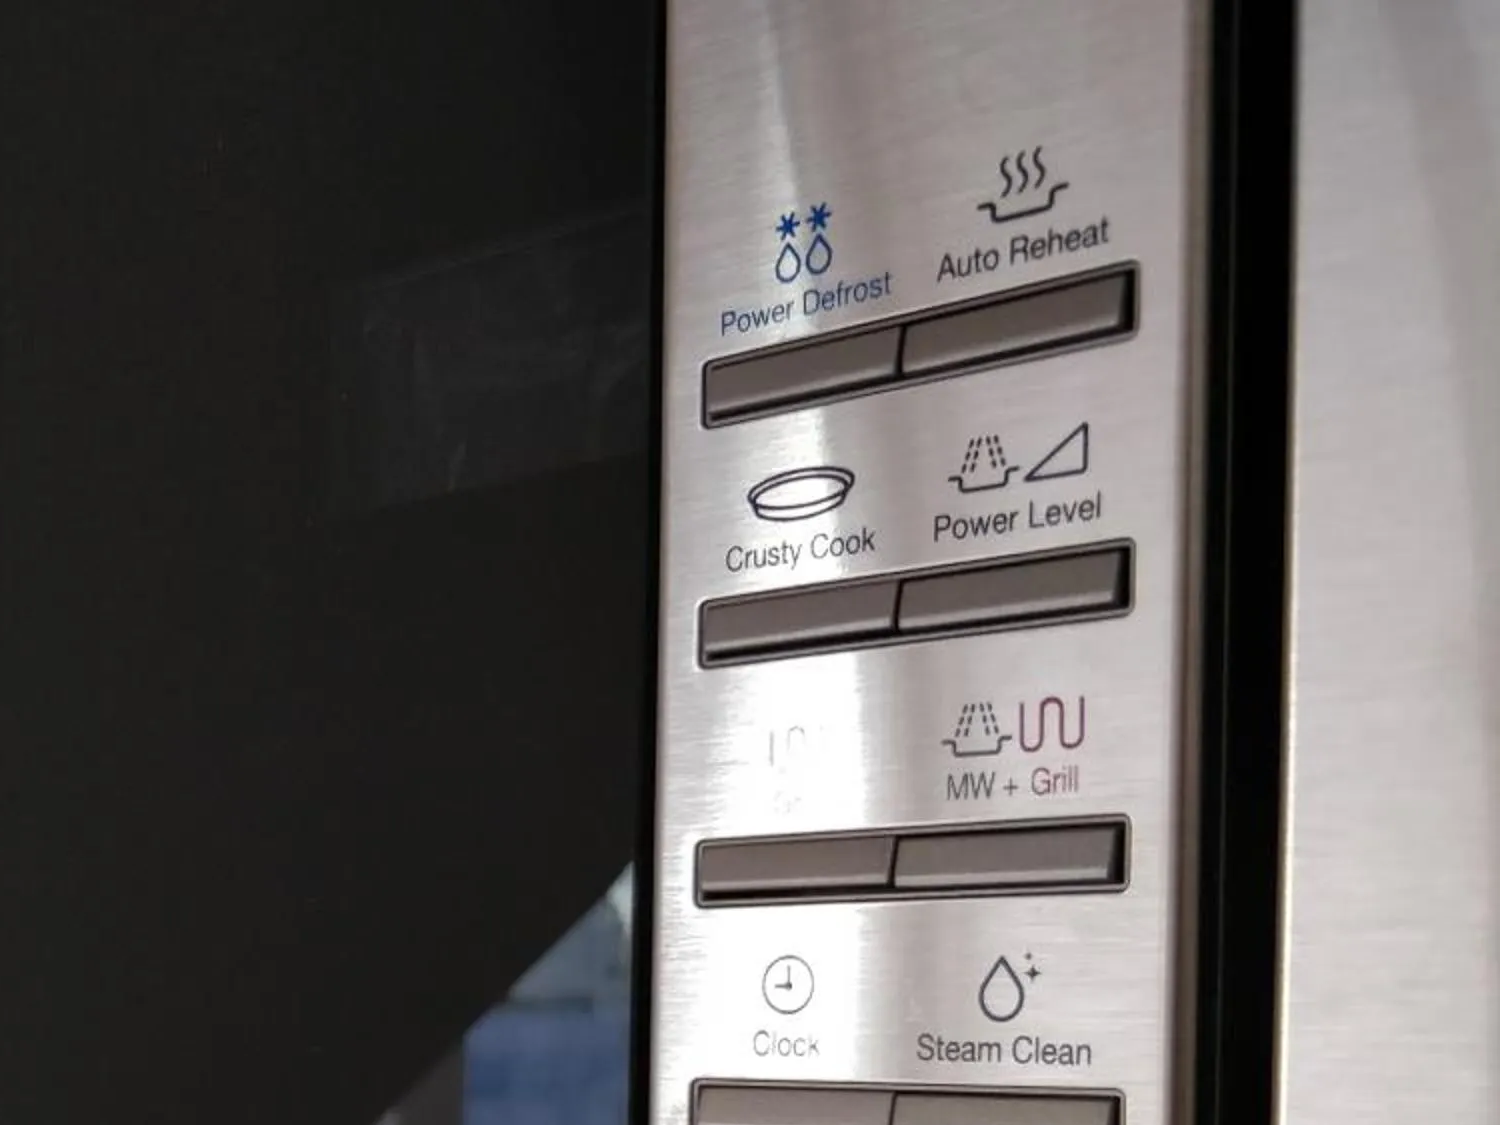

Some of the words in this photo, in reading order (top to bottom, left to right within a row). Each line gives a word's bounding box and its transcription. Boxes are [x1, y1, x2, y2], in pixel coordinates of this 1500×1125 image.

[936, 247, 1000, 282] Auto
[1009, 217, 1110, 261] Reheat
[720, 299, 793, 336] Power
[803, 272, 892, 315] Defrost
[934, 504, 1017, 542] Power
[1028, 493, 1102, 529] Level
[726, 536, 802, 573] Crusty
[810, 527, 876, 560] Cook
[946, 771, 996, 801] MW
[1031, 766, 1079, 797] Grill
[752, 1030, 819, 1057] Clock
[916, 1033, 1001, 1063] Steam
[1012, 1036, 1092, 1065] Clean
